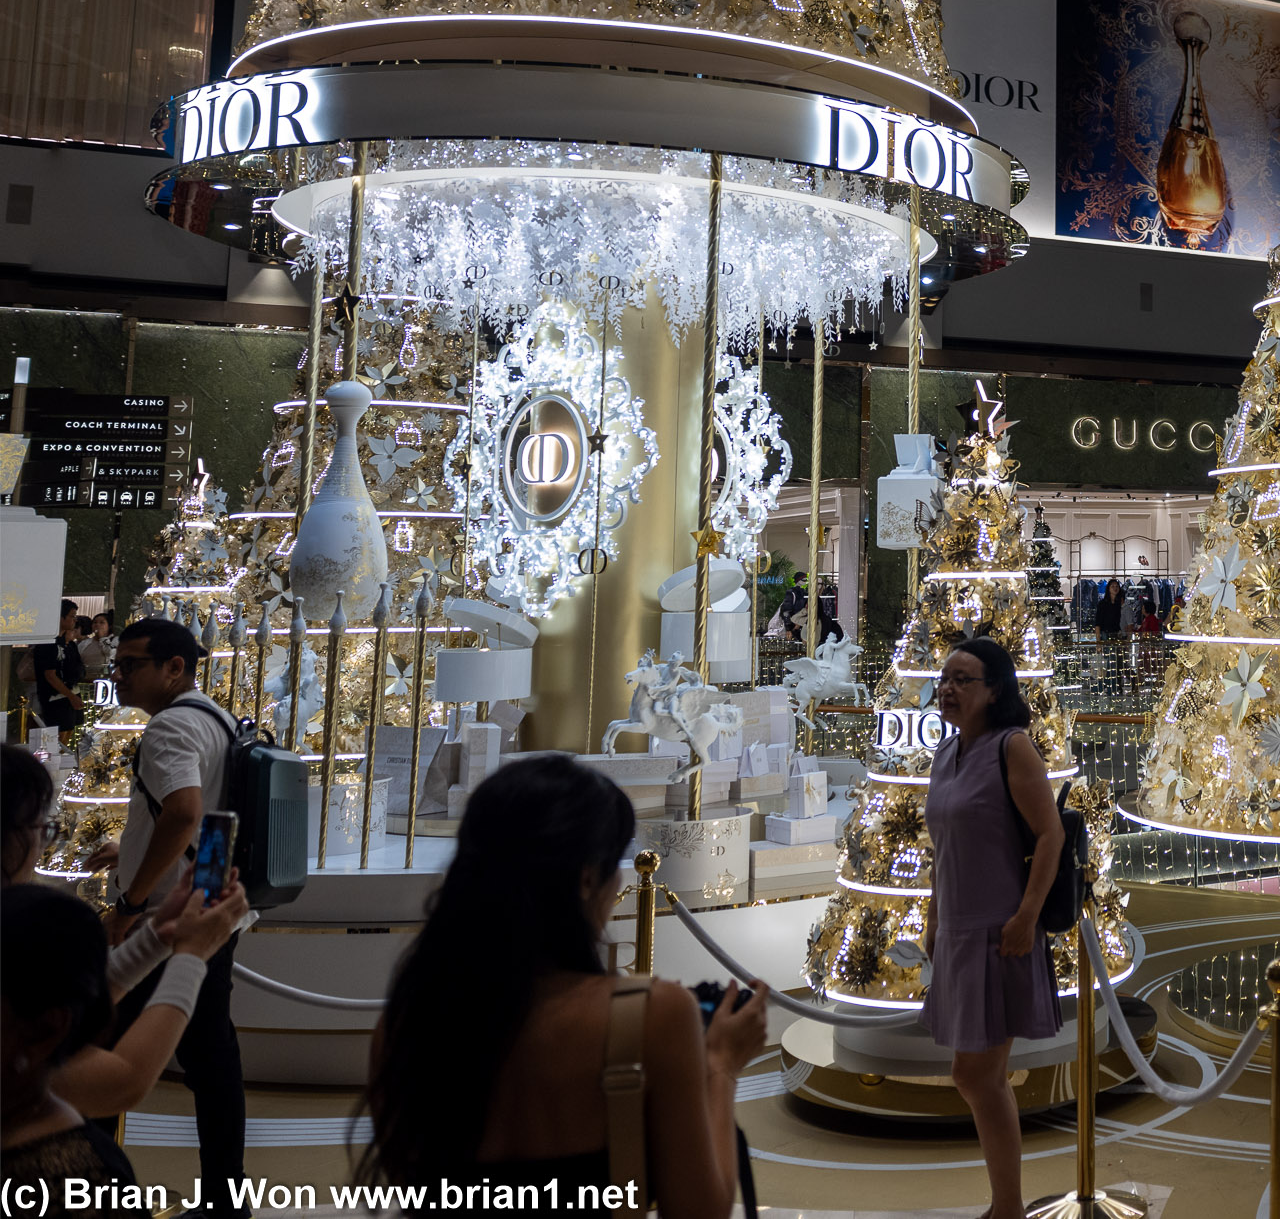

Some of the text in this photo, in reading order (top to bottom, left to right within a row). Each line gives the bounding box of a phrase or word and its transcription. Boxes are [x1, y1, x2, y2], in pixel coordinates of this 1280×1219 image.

[180, 81, 310, 164] DIOR
[824, 104, 975, 202] DIOR
[123, 398, 165, 407] CASINO
[65, 421, 163, 430] COACH TERMINAL
[42, 444, 162, 453] EXPO & CONVENTION
[60, 465, 79, 473] APPLE
[109, 468, 159, 476] SKYPARK
[92, 679, 115, 705] DI
[874, 710, 958, 750] DIO
